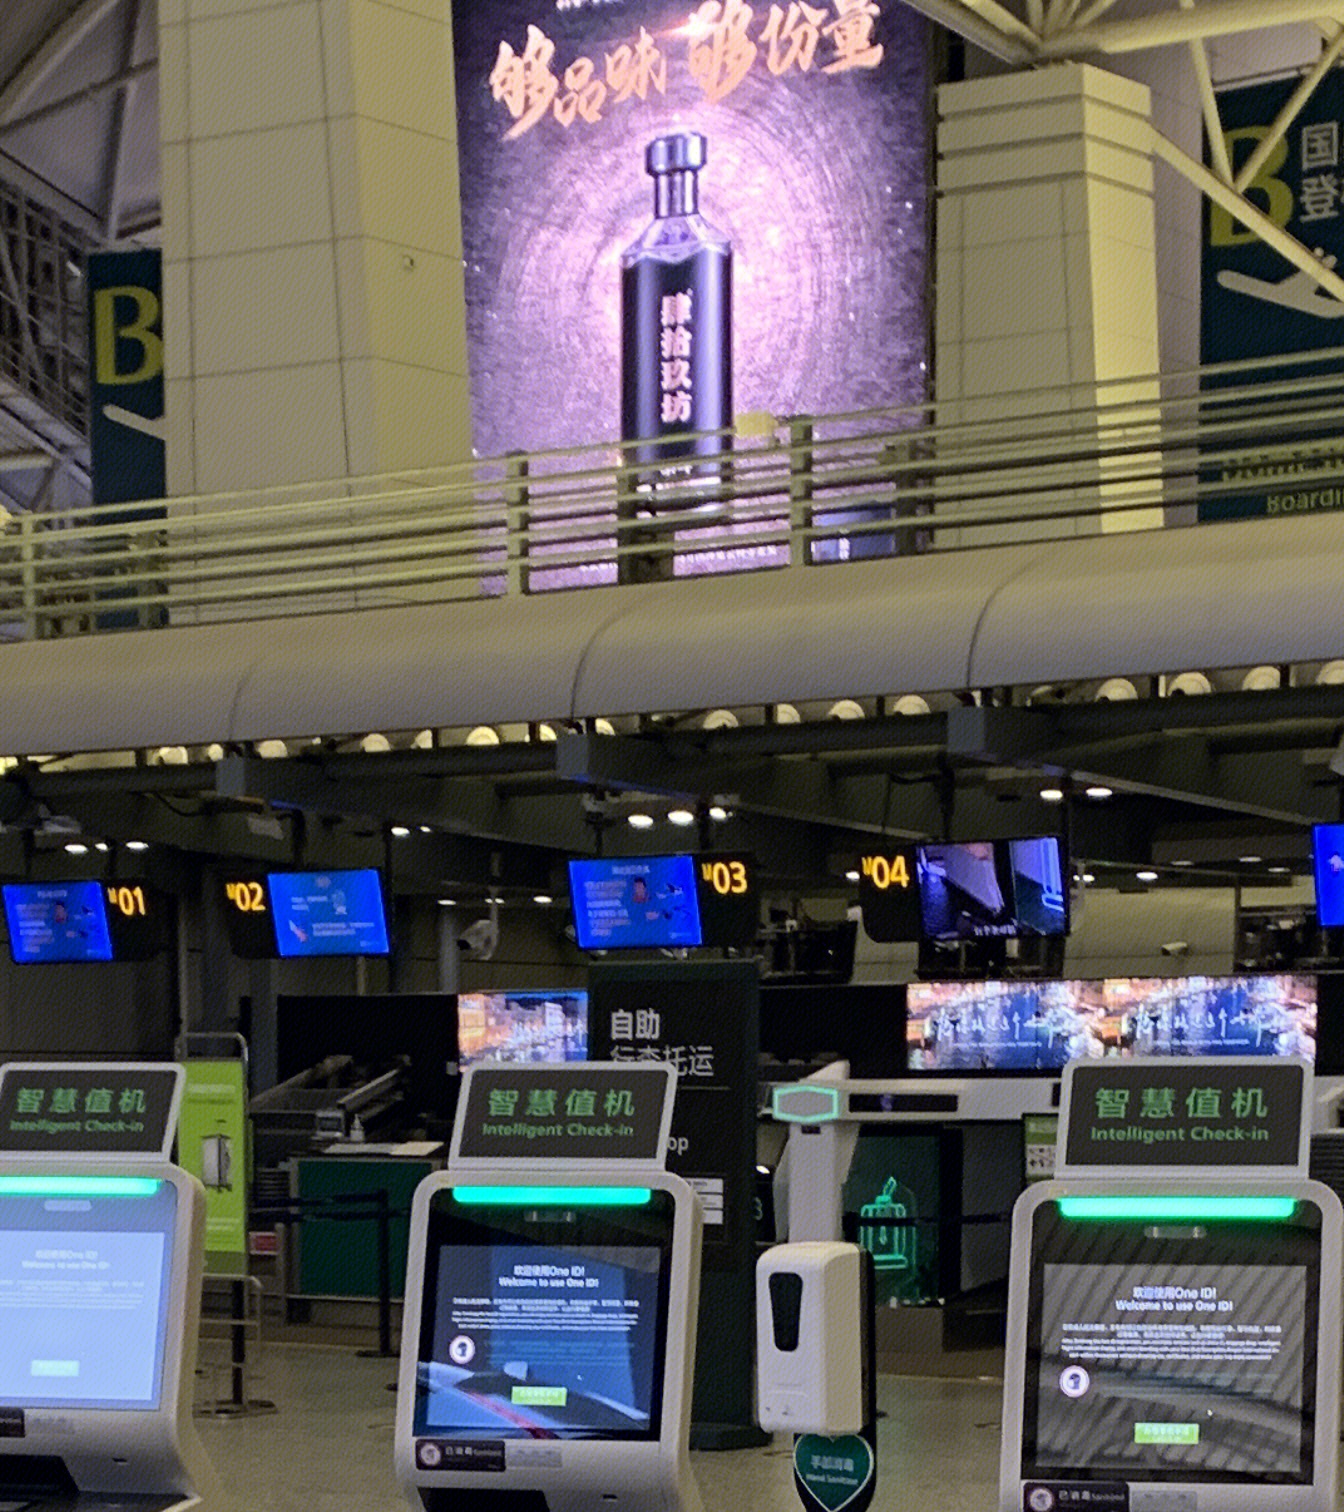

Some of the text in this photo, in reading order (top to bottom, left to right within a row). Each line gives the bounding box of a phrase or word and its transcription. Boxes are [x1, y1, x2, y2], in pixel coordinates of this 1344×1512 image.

[1210, 124, 1295, 247] B
[94, 285, 164, 385] B
[701, 861, 748, 895] M03
[861, 855, 910, 889] M04
[610, 1008, 661, 1041] 自助
[16, 1087, 146, 1114] 智慧值机
[487, 1088, 636, 1118] 智慧值机
[1095, 1087, 1269, 1120] 智慧值机
[482, 1122, 635, 1139] Intelligent Check-in
[1090, 1126, 1269, 1145] Intelligent Check-in
